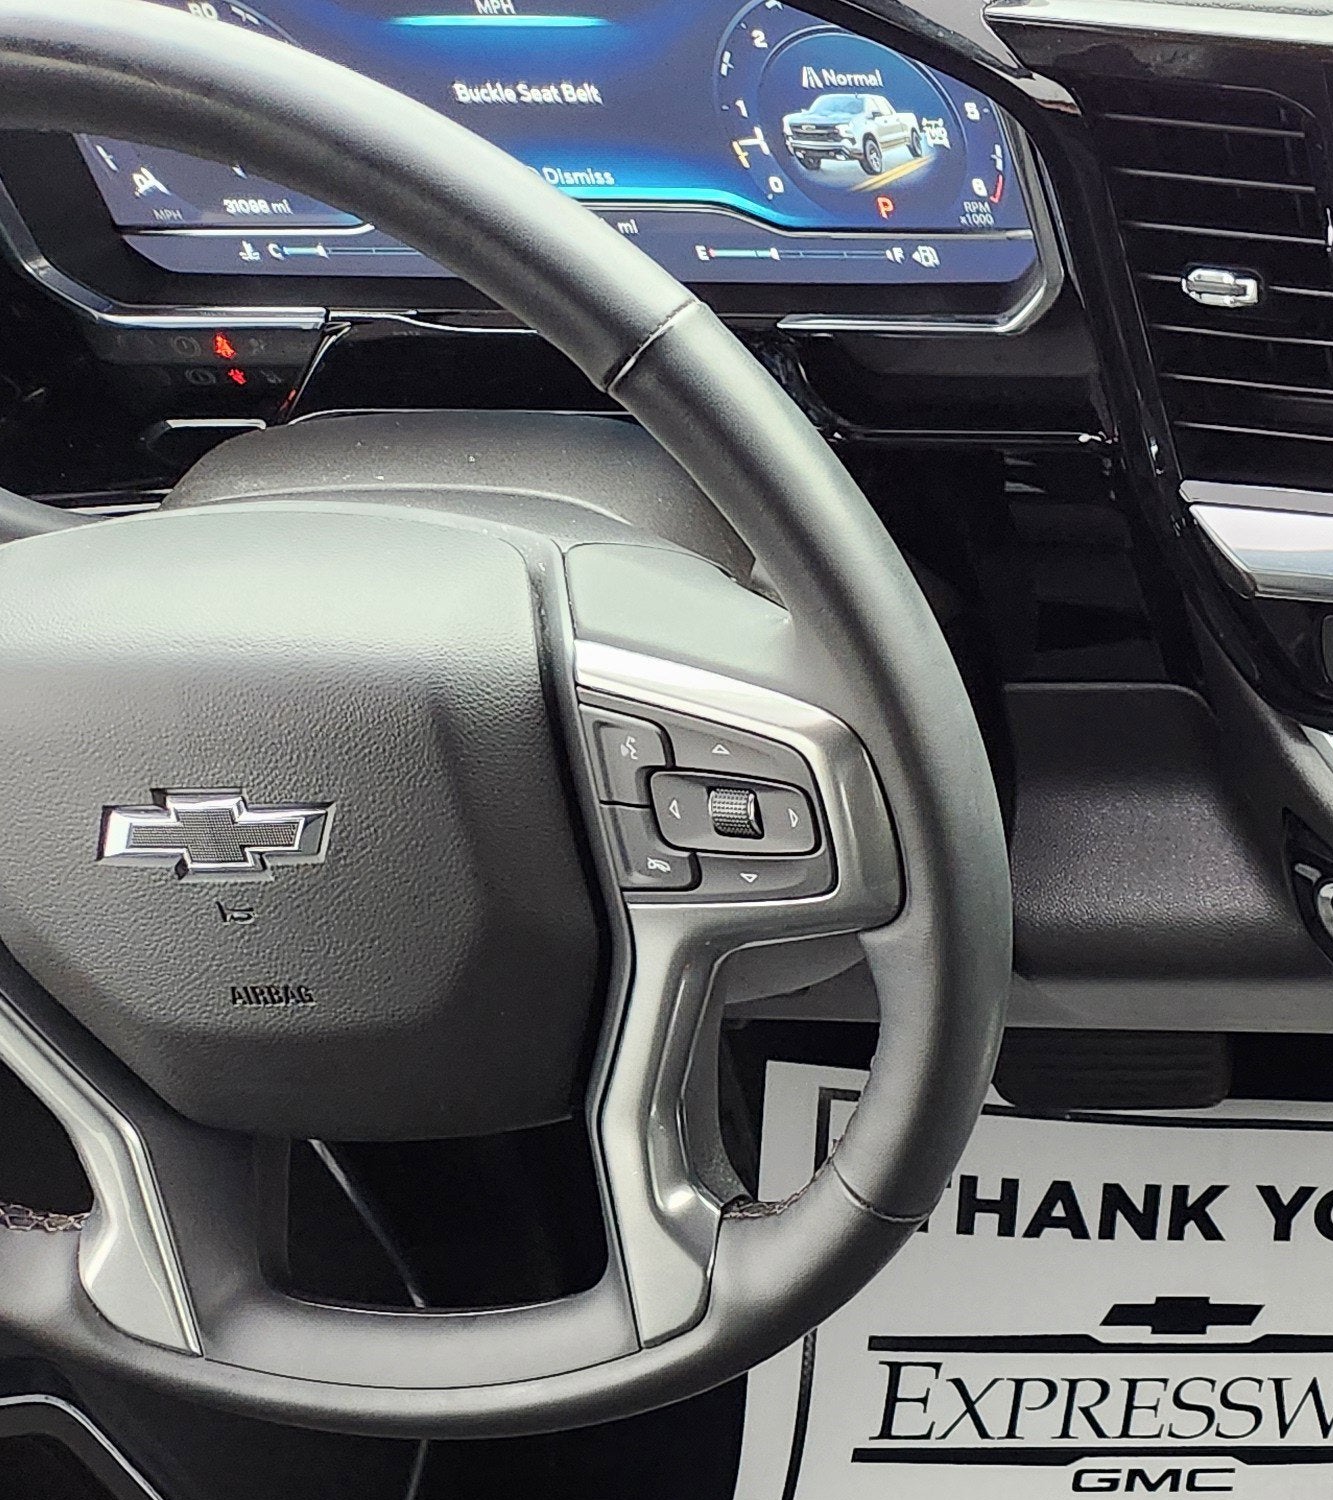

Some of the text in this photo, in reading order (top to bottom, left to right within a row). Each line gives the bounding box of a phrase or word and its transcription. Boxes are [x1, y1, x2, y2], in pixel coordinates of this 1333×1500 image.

[751, 30, 768, 48] 2
[822, 68, 883, 88] Normal
[453, 82, 603, 105] Buckle Seat Belt
[735, 99, 748, 118] 1
[543, 167, 615, 186] Dismiss
[769, 175, 785, 193] 0
[153, 208, 183, 222] MPH
[877, 196, 894, 218] P
[963, 201, 991, 213] RPM
[696, 245, 710, 260] E
[230, 984, 315, 1006] AIRBAG
[917, 1174, 1229, 1241] HANK
[1071, 1467, 1236, 1493] GMC
